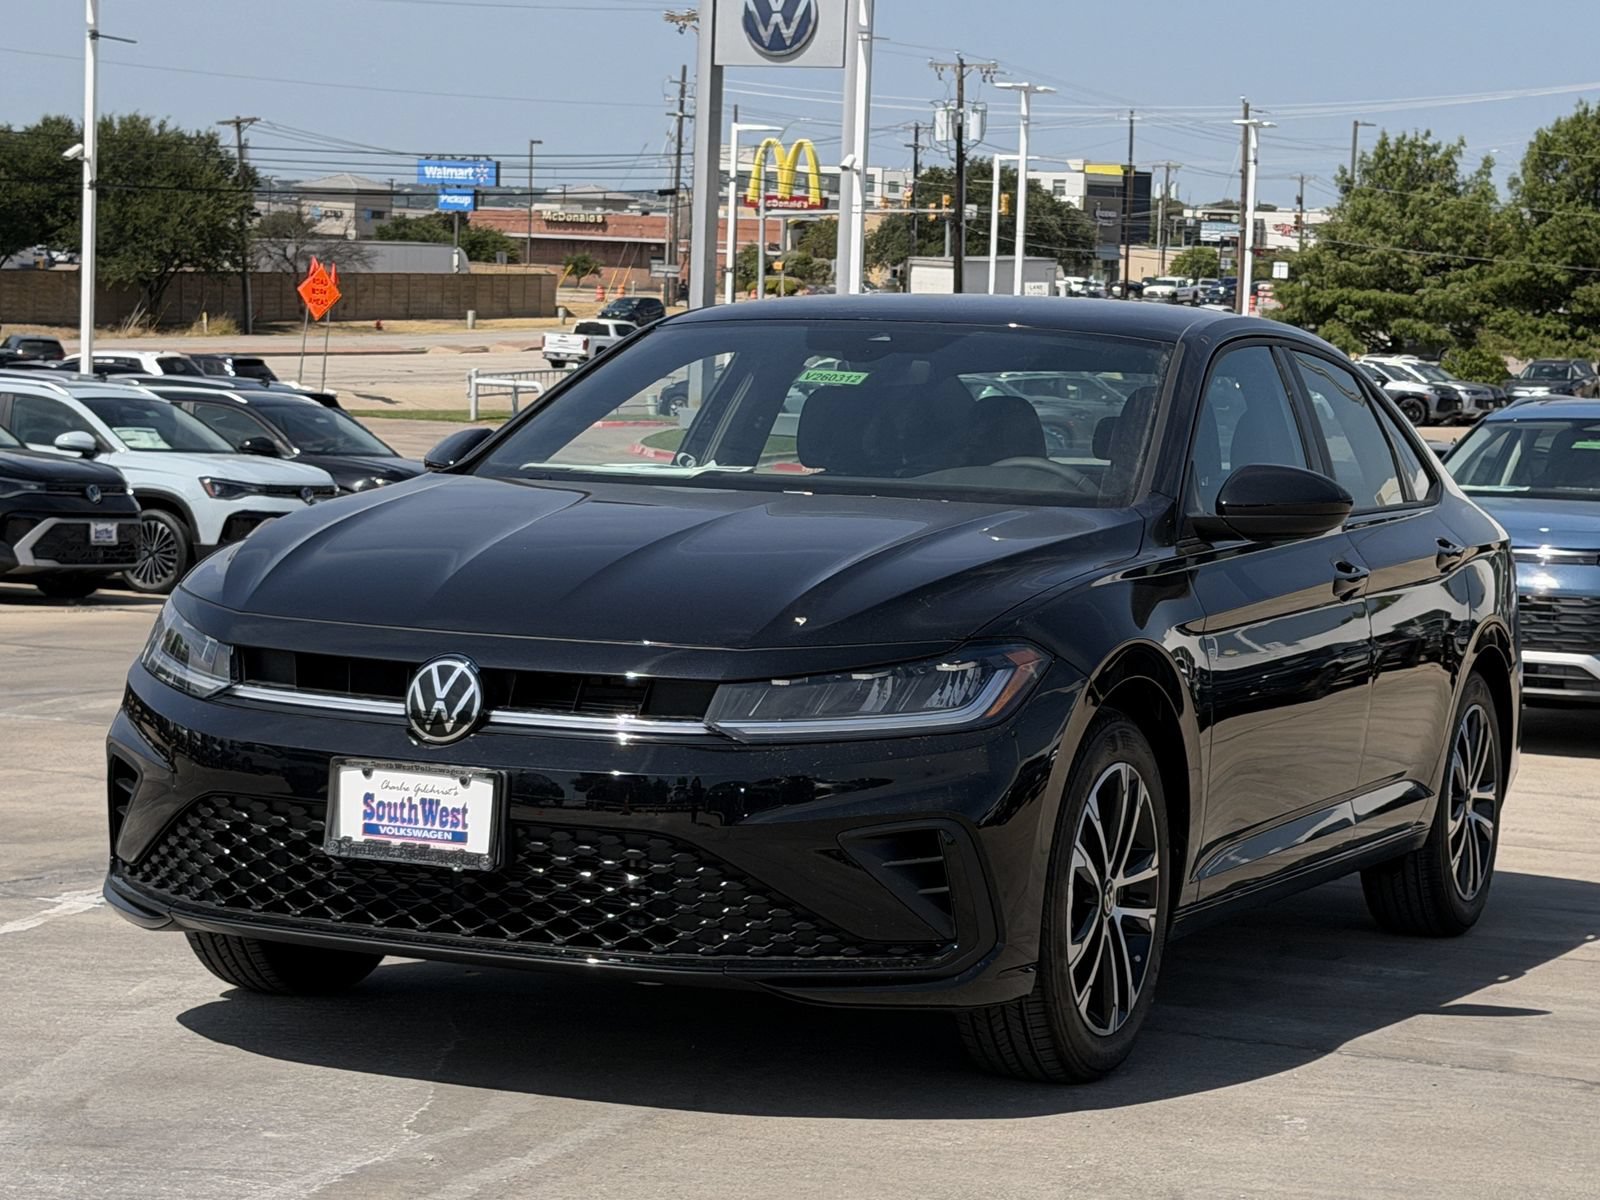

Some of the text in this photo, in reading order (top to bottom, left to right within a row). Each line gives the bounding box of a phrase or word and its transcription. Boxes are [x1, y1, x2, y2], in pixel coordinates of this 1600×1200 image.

[424, 166, 474, 179] Walmart
[758, 199, 808, 209] cDonald's
[804, 372, 862, 382] V260312
[379, 825, 453, 841] VOLKSWAGEN
